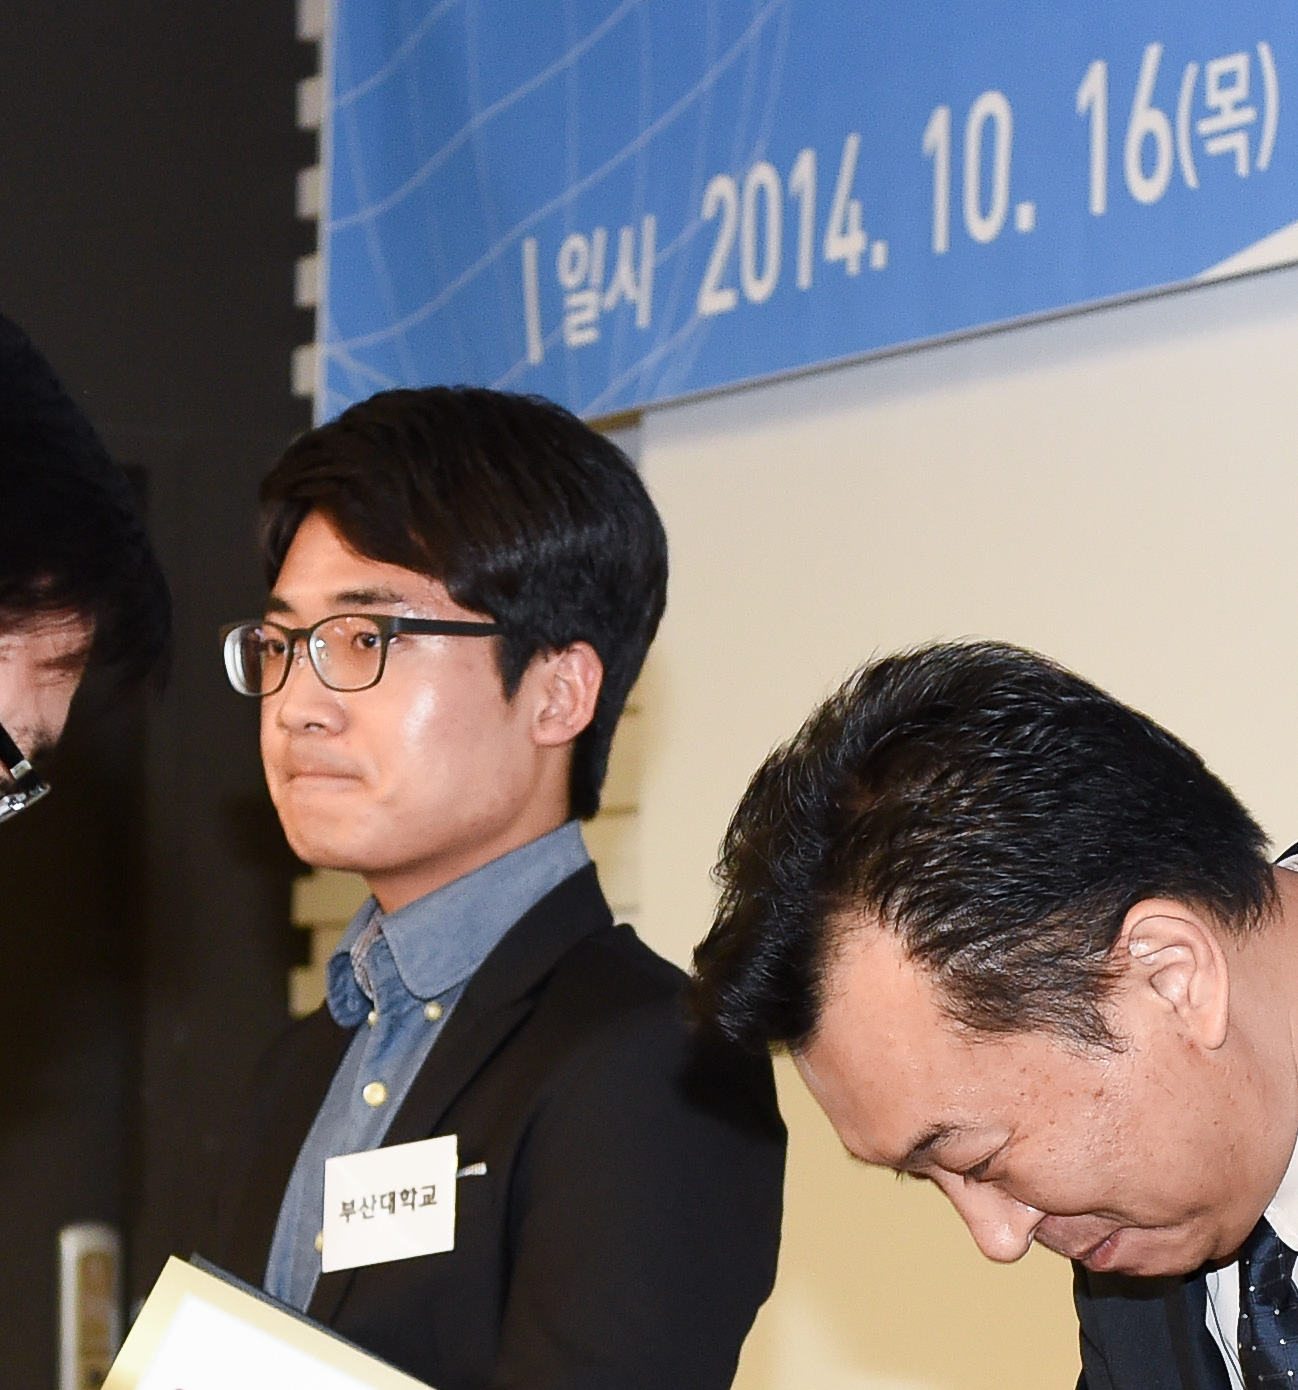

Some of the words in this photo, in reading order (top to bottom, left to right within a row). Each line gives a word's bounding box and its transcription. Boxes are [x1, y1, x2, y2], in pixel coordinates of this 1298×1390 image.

[556, 214, 657, 350] 일시
[698, 132, 888, 318] 2014.
[922, 90, 1036, 255] 10.
[1076, 42, 1280, 218] 16(목)
[339, 1184, 437, 1223] 부산대학교
